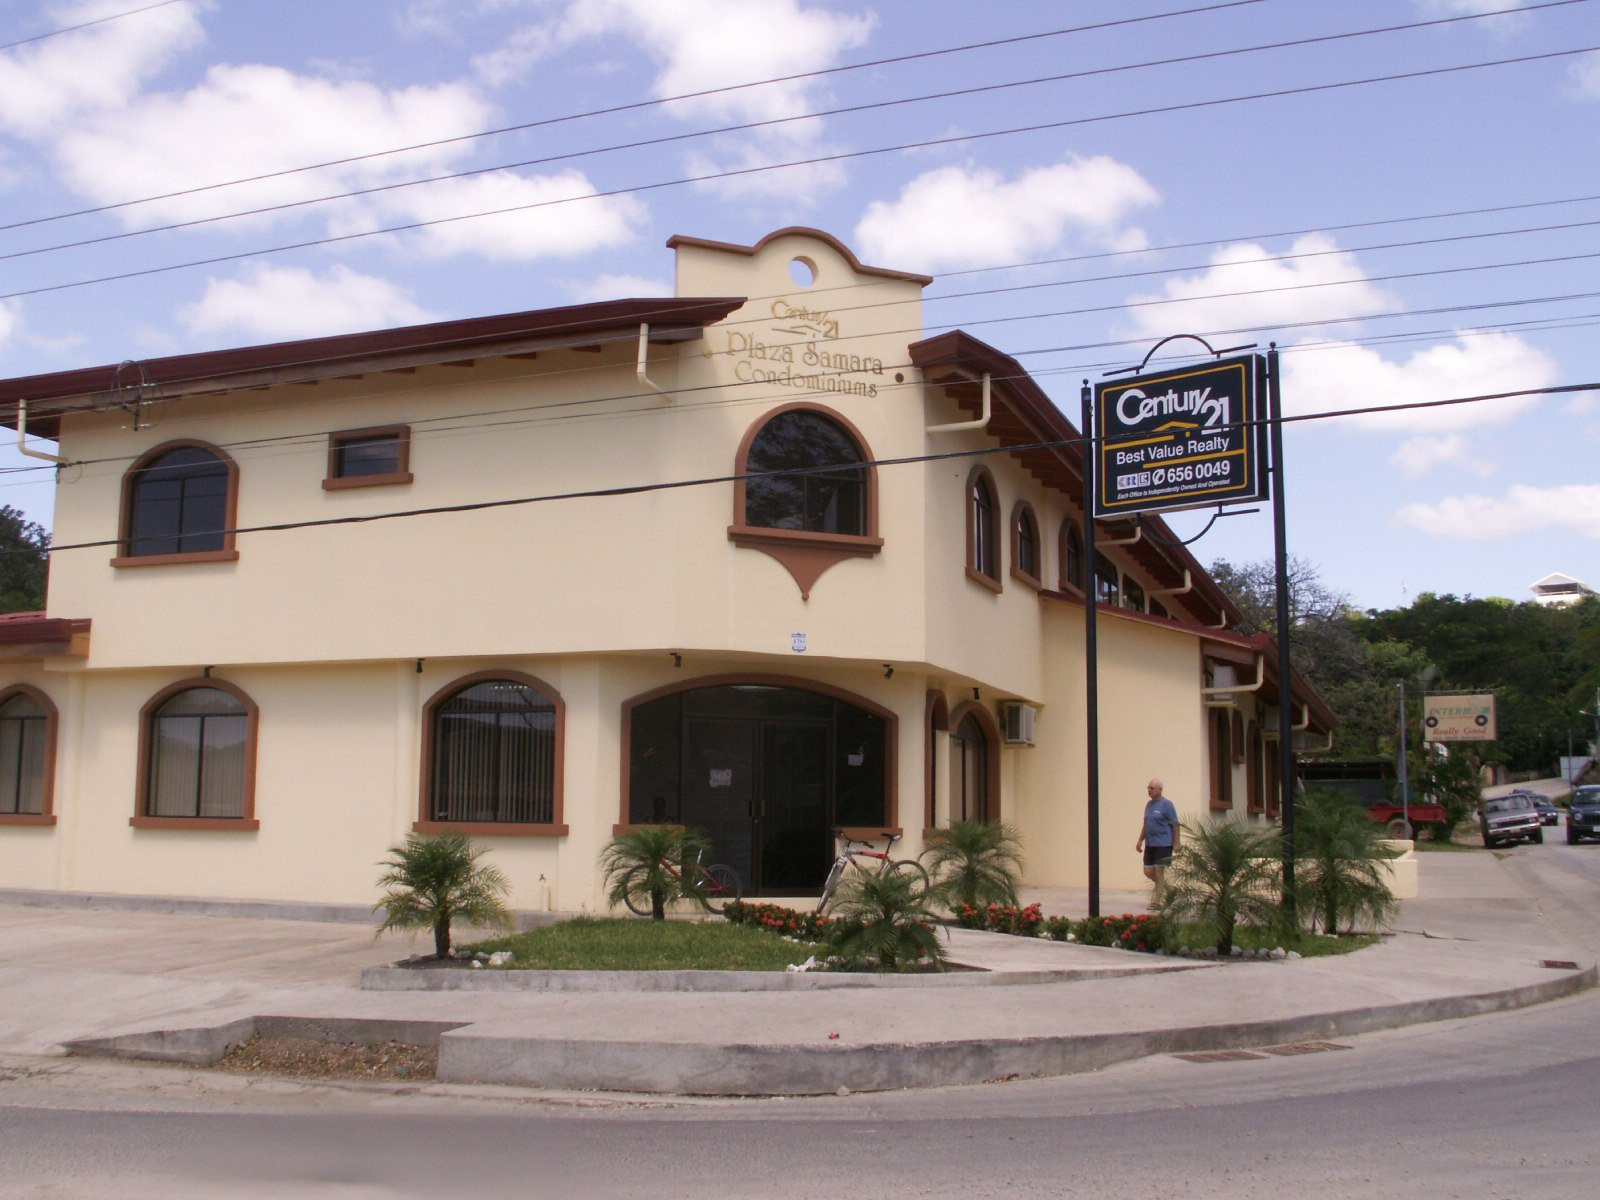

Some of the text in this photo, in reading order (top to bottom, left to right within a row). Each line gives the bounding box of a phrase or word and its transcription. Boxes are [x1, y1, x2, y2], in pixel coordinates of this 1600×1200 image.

[822, 320, 839, 340] 21
[726, 330, 884, 376] Plaza Samara
[734, 360, 878, 398] Condominiums
[1116, 386, 1230, 435] Century 21
[1116, 436, 1230, 465] Best Value Realty
[1167, 466, 1193, 483] 656
[1195, 460, 1230, 479] 0049
[1117, 491, 1129, 500] Each
[1129, 489, 1142, 498] Office
[1433, 726, 1487, 736] Really Good
